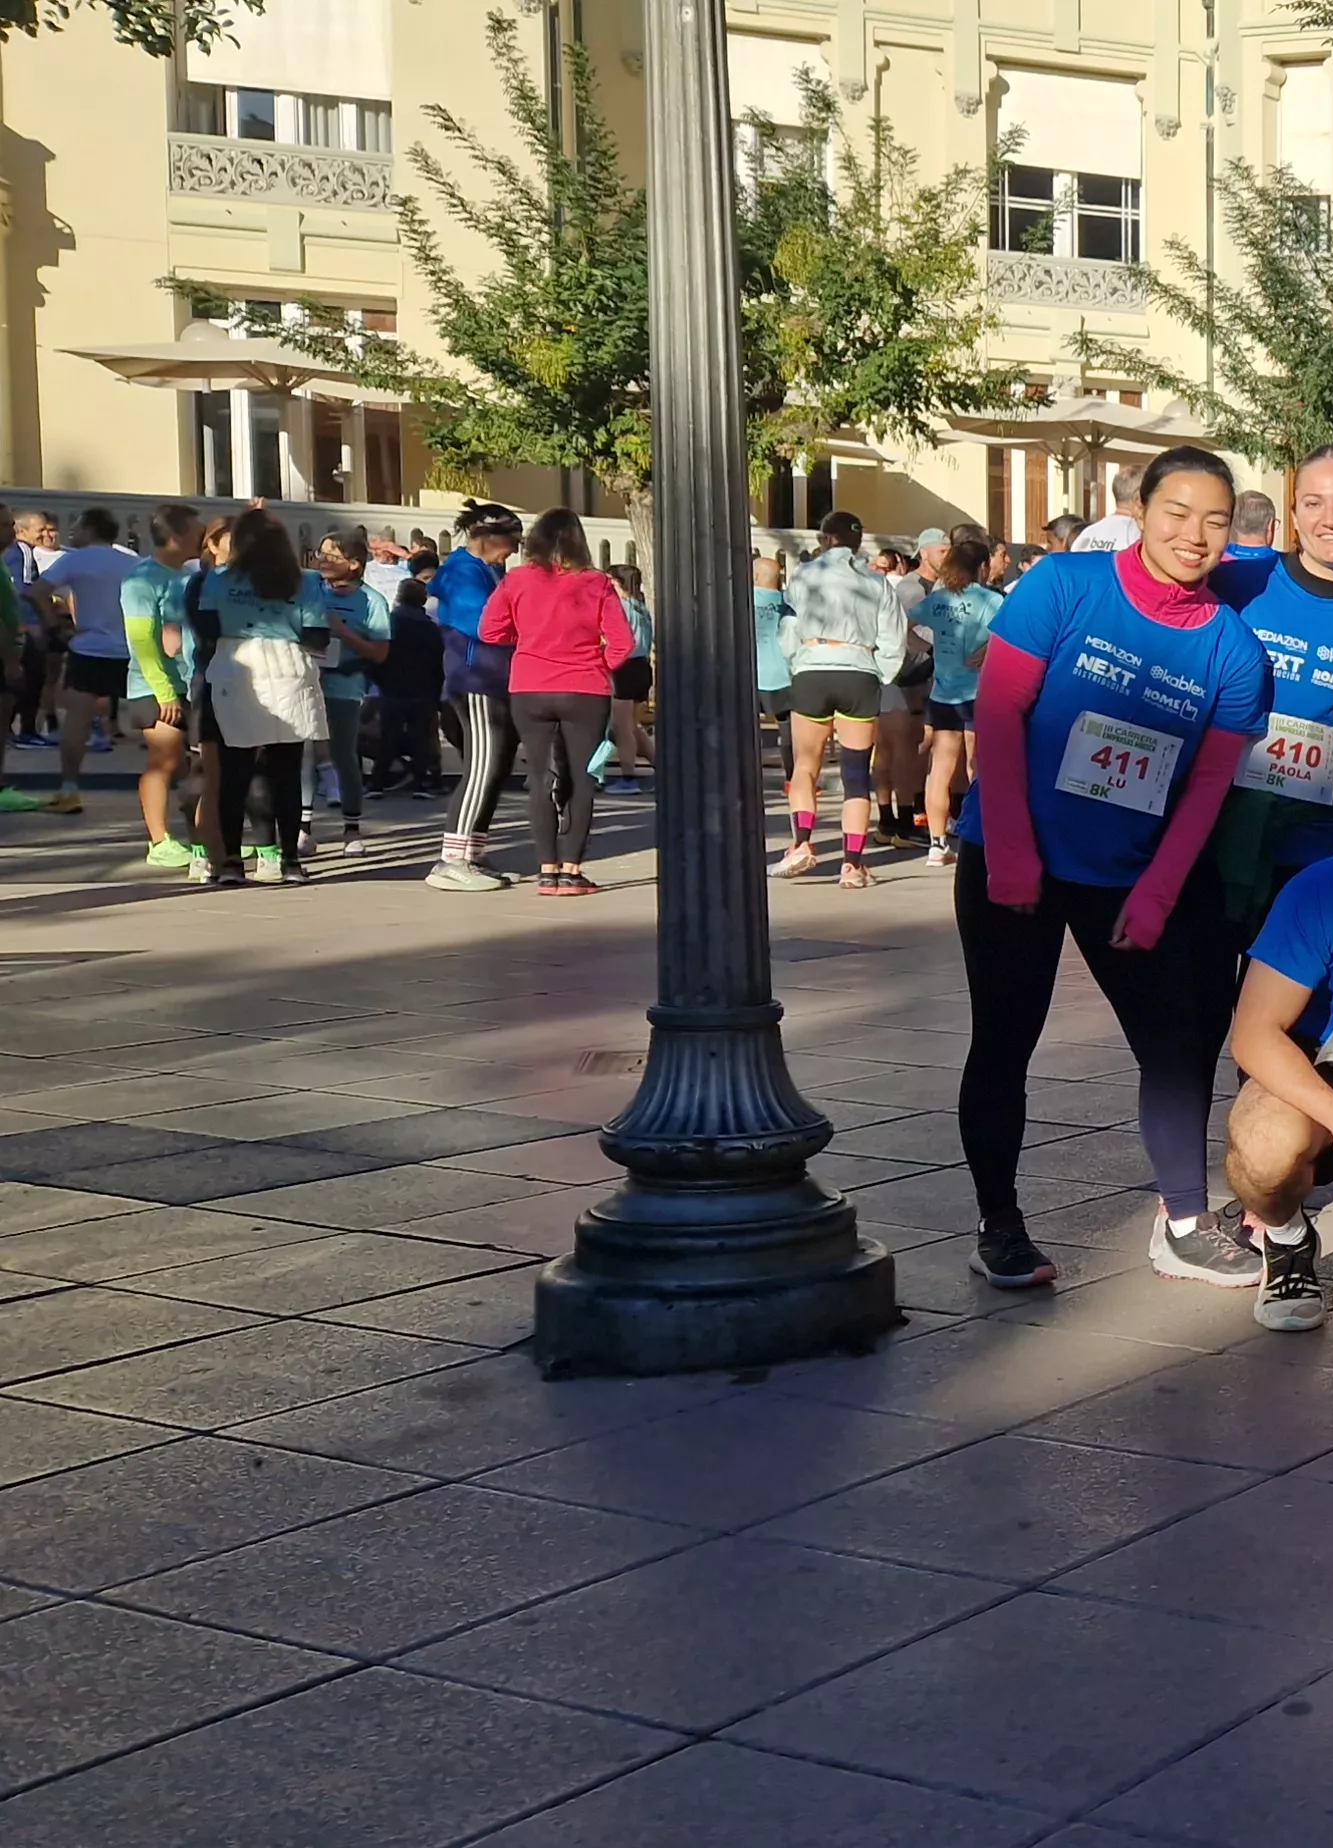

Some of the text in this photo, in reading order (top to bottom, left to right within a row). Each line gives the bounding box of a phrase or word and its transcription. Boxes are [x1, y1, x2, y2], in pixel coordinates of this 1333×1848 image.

[1085, 635, 1142, 667] MEDIAZION
[1076, 653, 1136, 686] NEXT
[1162, 669, 1206, 698] kablex
[1144, 687, 1181, 709] HOME
[1115, 727, 1158, 745] CARRERA
[1091, 746, 1149, 779] 411
[1267, 737, 1321, 768] 410
[1108, 776, 1126, 788] LU
[1267, 774, 1285, 788] 8K
[1269, 763, 1311, 781] PAOLA
[1090, 784, 1110, 799] 8K
